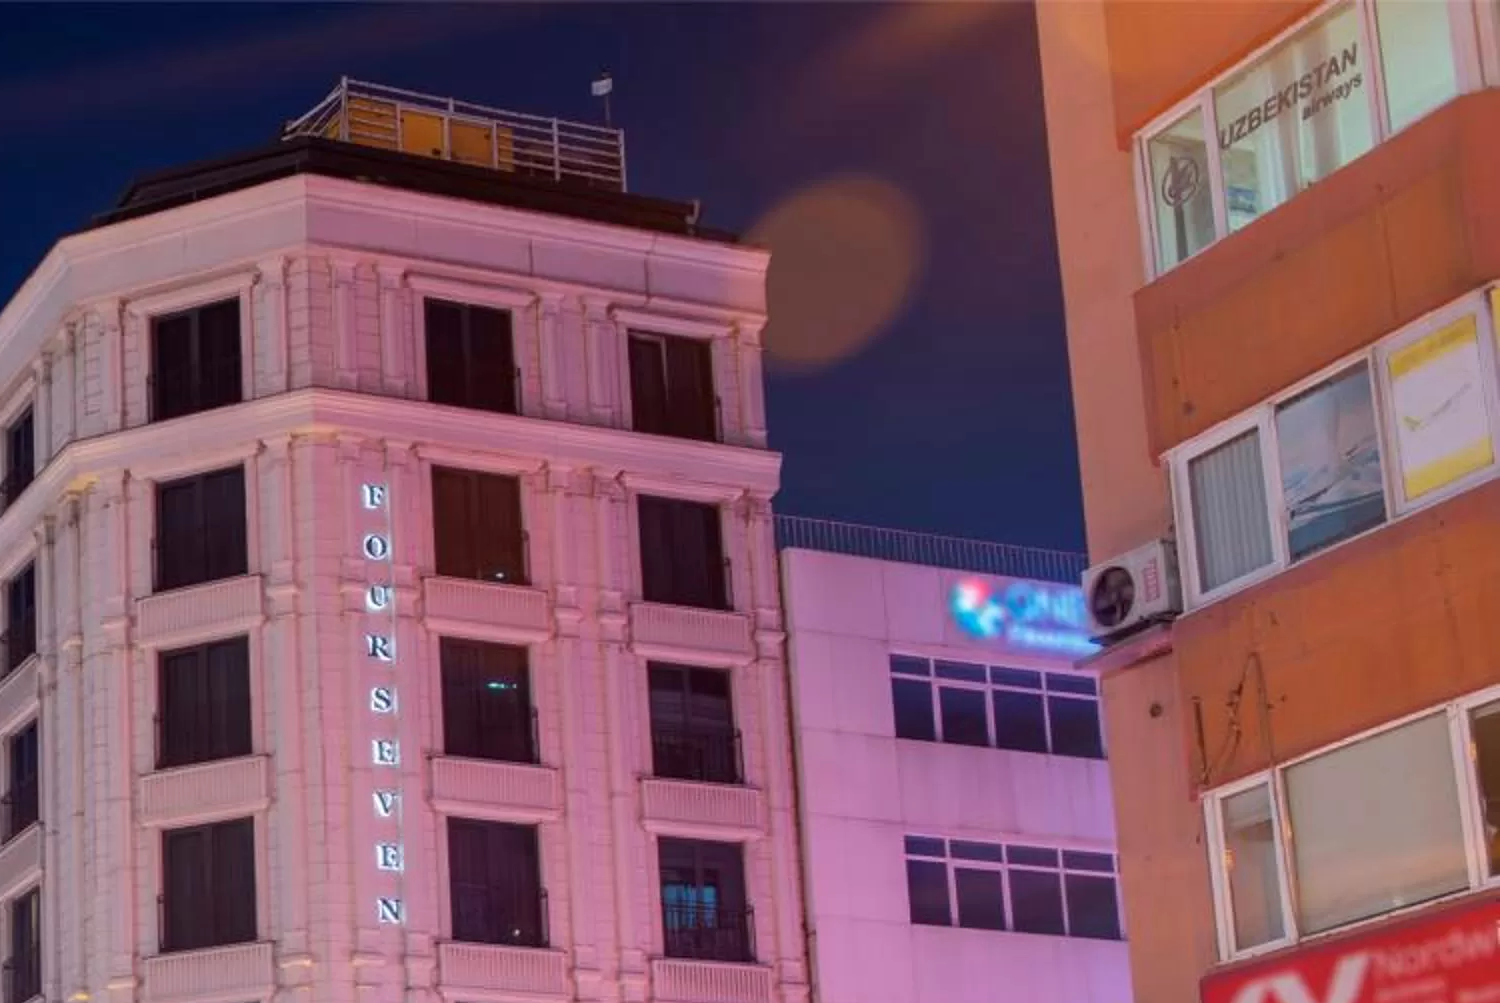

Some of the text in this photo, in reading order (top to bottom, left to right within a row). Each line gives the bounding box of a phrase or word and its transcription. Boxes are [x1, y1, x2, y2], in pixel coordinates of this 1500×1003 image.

[1219, 42, 1358, 150] UZBEKISTAN
[1302, 73, 1363, 121] airways
[363, 483, 405, 924] FOURSEVEN
